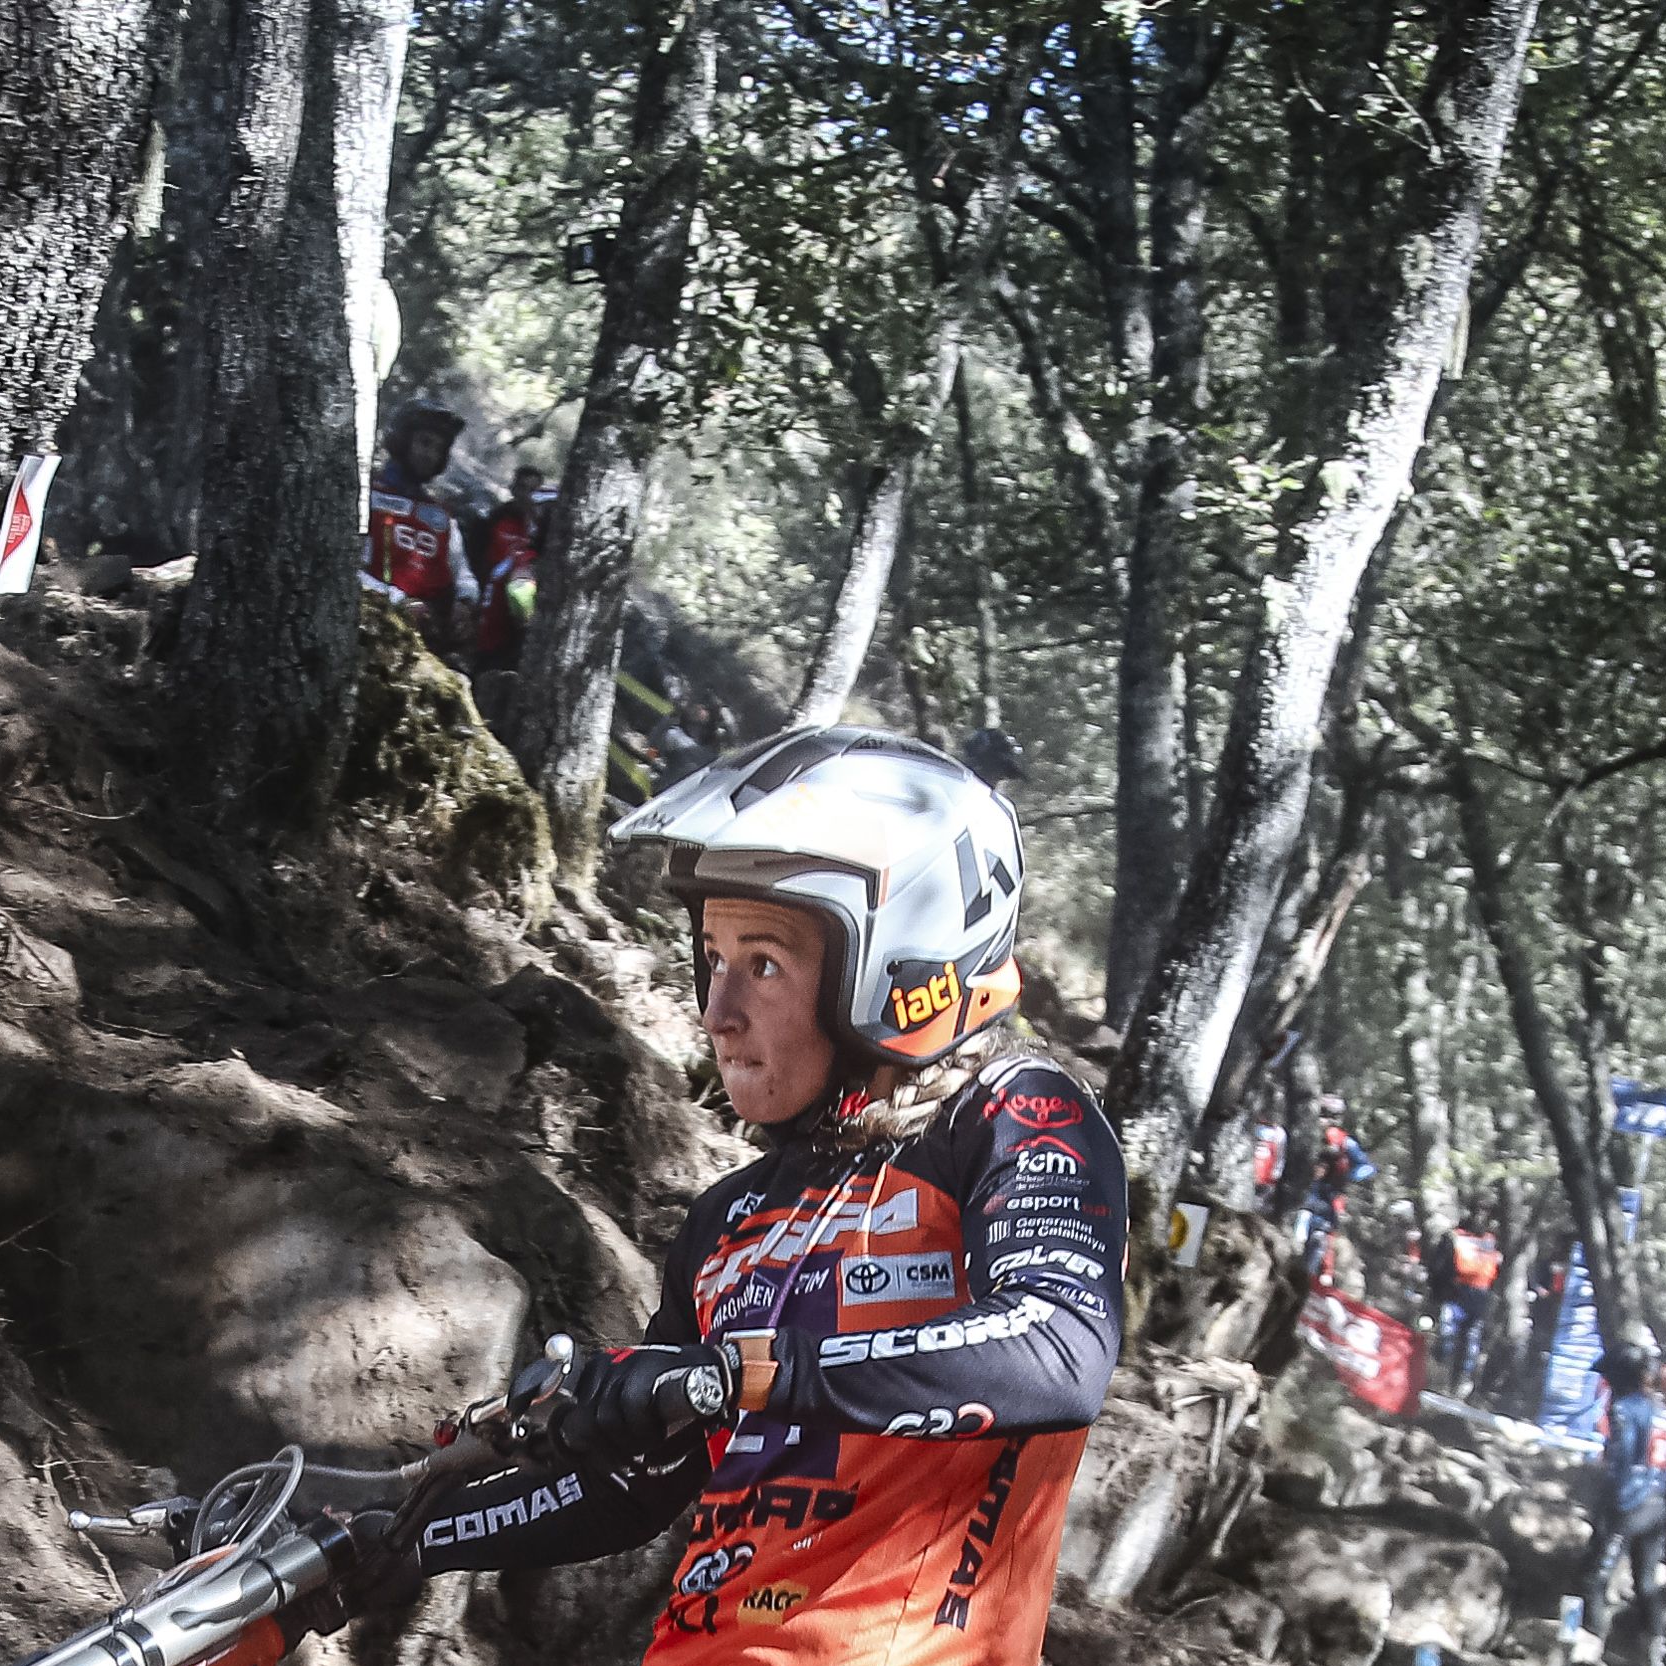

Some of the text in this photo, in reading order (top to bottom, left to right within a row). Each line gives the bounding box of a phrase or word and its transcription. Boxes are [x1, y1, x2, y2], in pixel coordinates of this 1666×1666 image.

[890, 960, 962, 1031] iati
[1015, 1150, 1078, 1175] fcm
[906, 1263, 950, 1282] CSM
[988, 1245, 1105, 1281] GALFER
[423, 1471, 584, 1549] COMAS
[933, 1440, 1023, 1633] OMAS
